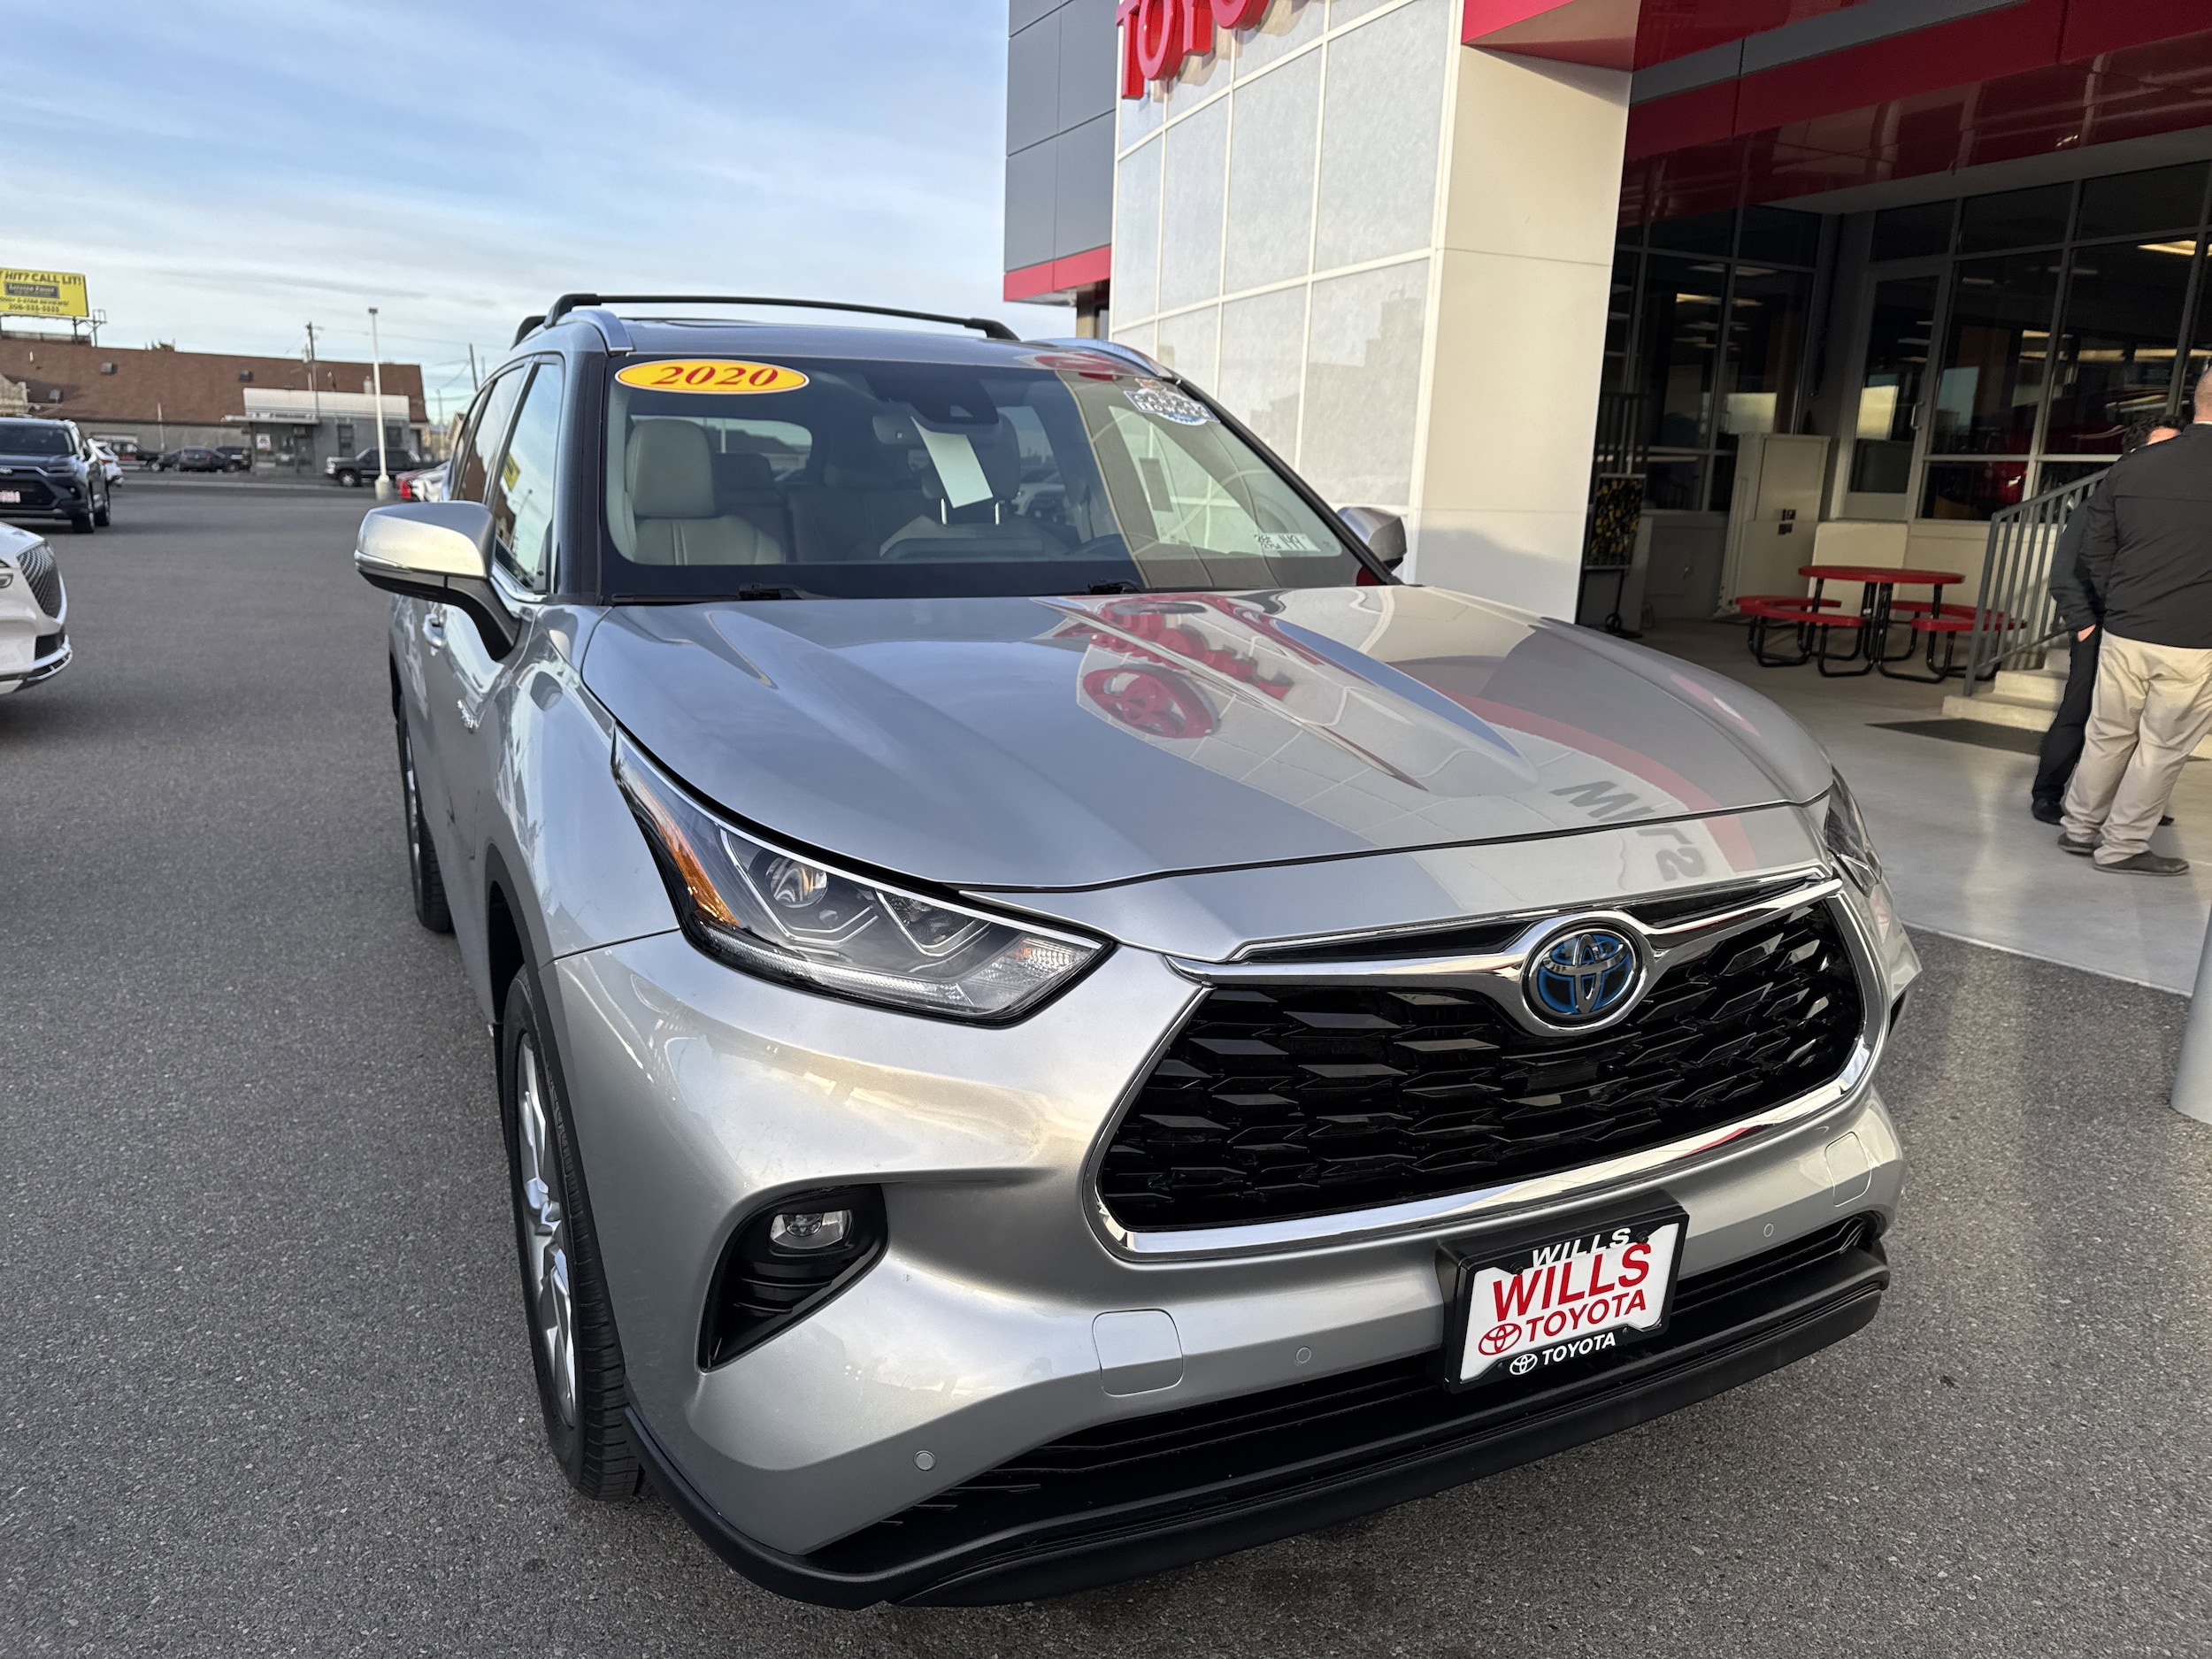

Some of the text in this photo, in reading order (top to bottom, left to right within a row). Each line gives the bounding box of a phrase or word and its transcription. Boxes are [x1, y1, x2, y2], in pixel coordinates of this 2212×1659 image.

[5, 272, 29, 281] HIT?
[32, 273, 60, 283] CALL
[63, 275, 81, 285] LIT!
[650, 365, 779, 387] 2020
[1532, 1227, 1632, 1267] WILLS
[1493, 1242, 1652, 1322] WILLS
[1525, 1289, 1647, 1342] TOYOTA
[1542, 1332, 1617, 1366] TOYOTA
